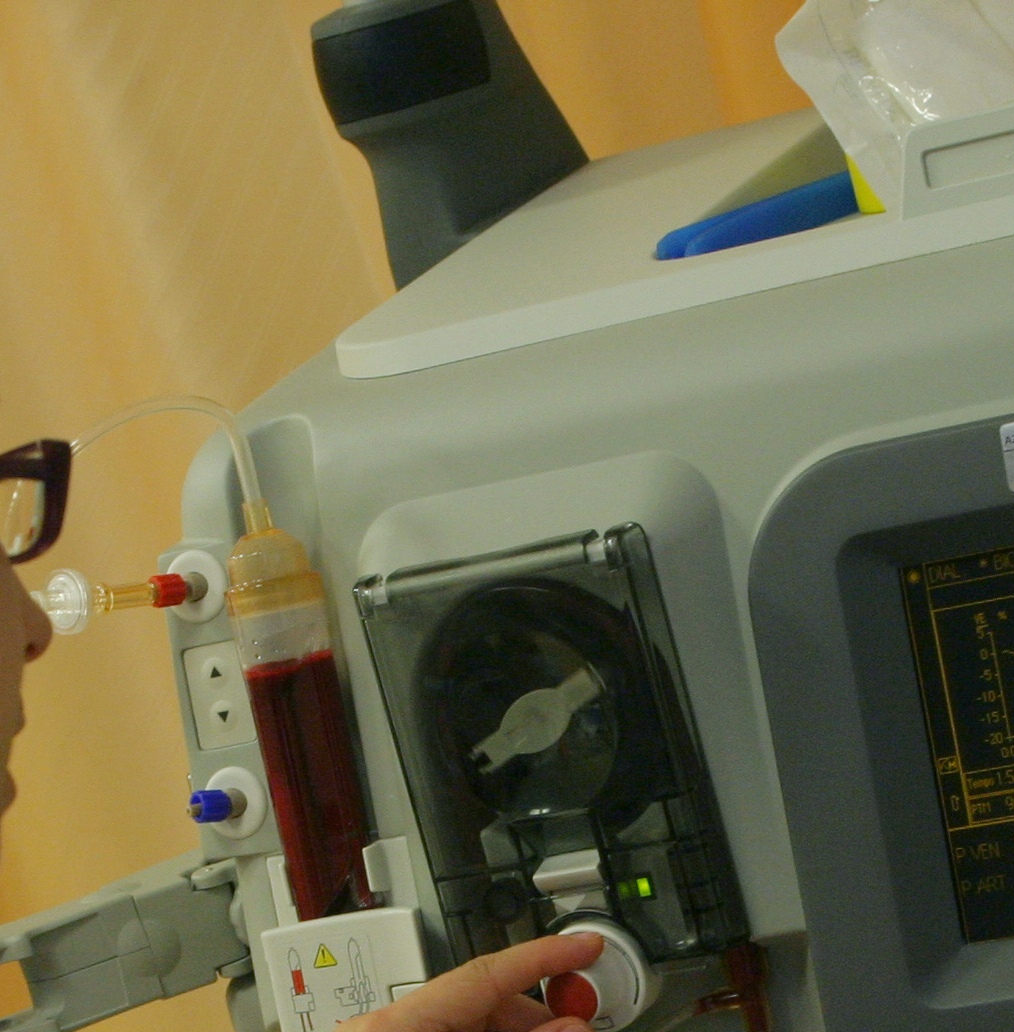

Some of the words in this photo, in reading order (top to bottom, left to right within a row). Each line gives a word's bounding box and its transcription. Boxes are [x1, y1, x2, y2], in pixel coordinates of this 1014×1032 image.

[976, 690, 996, 703] -10
[980, 711, 1000, 724] -15
[985, 732, 1004, 745] -20
